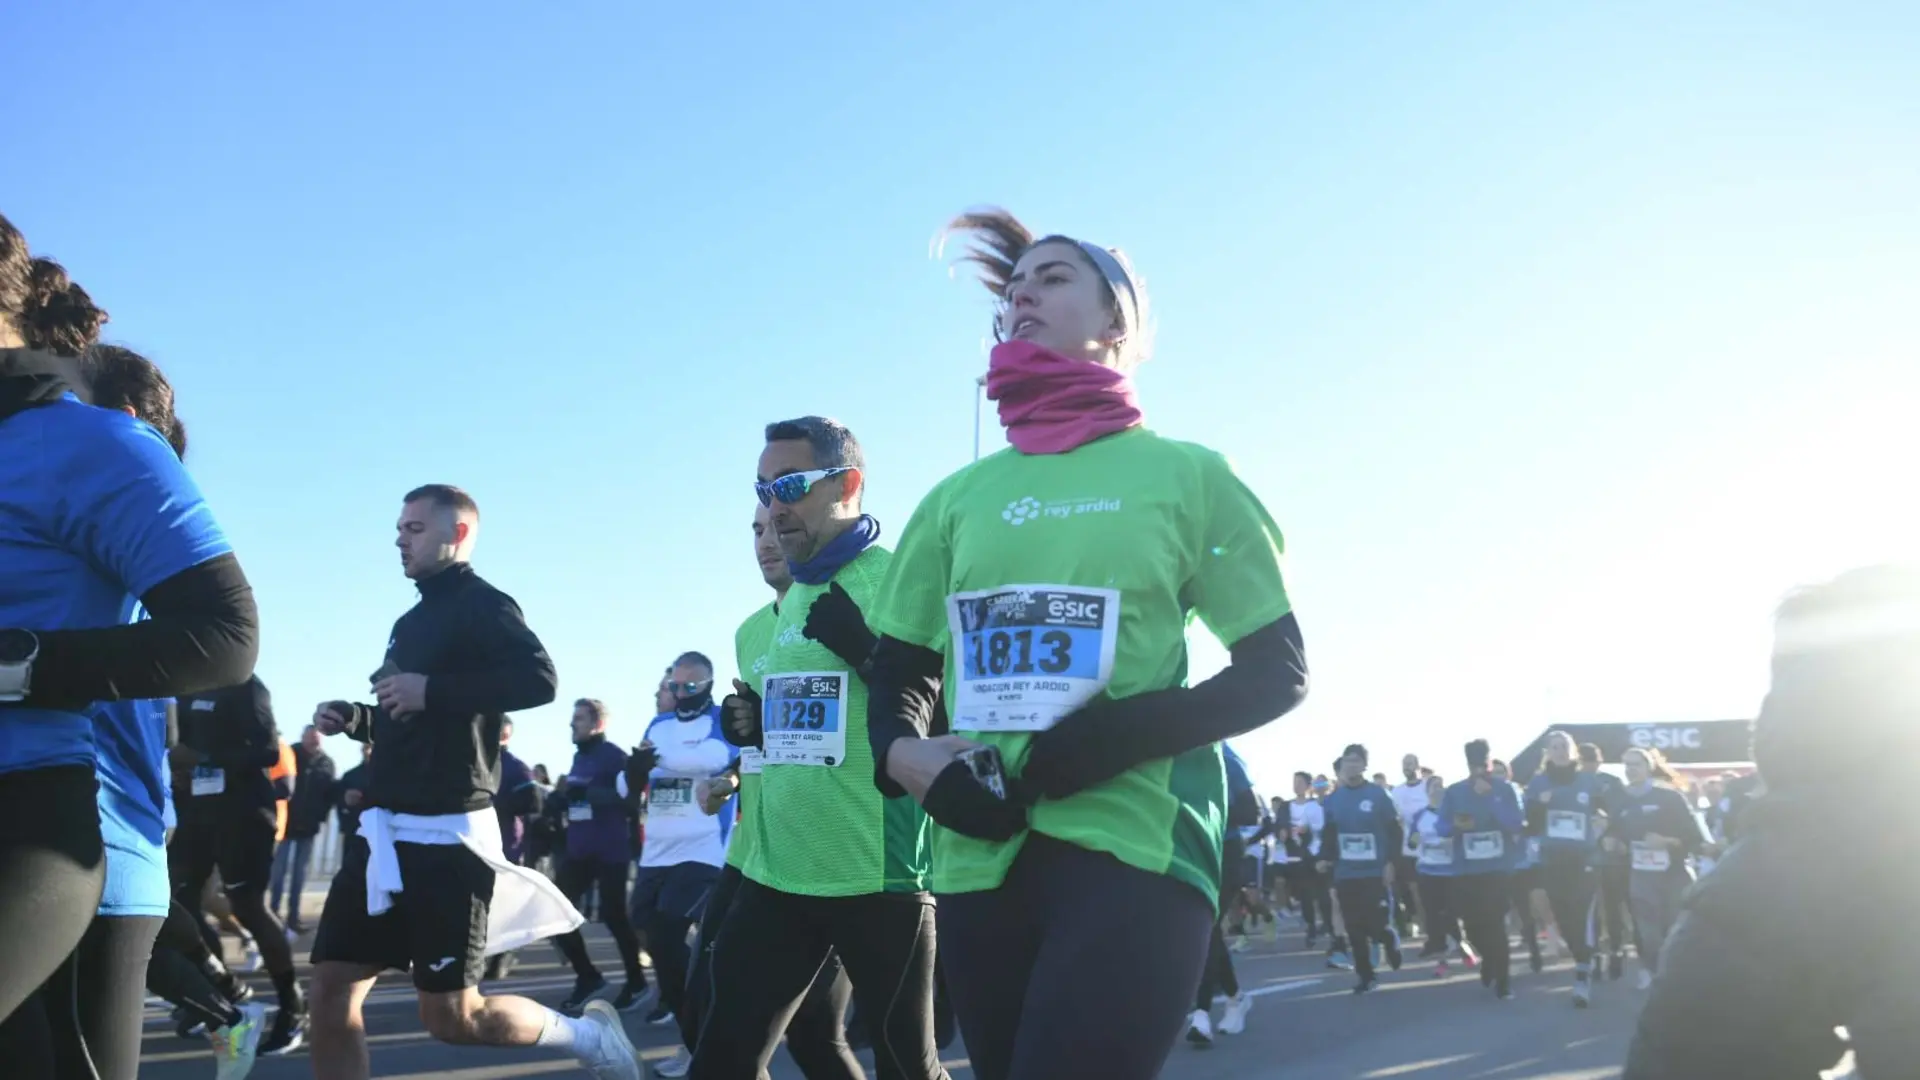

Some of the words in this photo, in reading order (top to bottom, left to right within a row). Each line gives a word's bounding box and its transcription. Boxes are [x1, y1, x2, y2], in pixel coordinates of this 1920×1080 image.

[1044, 504, 1071, 518] rey
[1075, 497, 1121, 514] ardid
[1048, 600, 1099, 620] esic
[972, 629, 1072, 676] 1813
[1012, 681, 1031, 691] REY
[1629, 726, 1701, 749] esic
